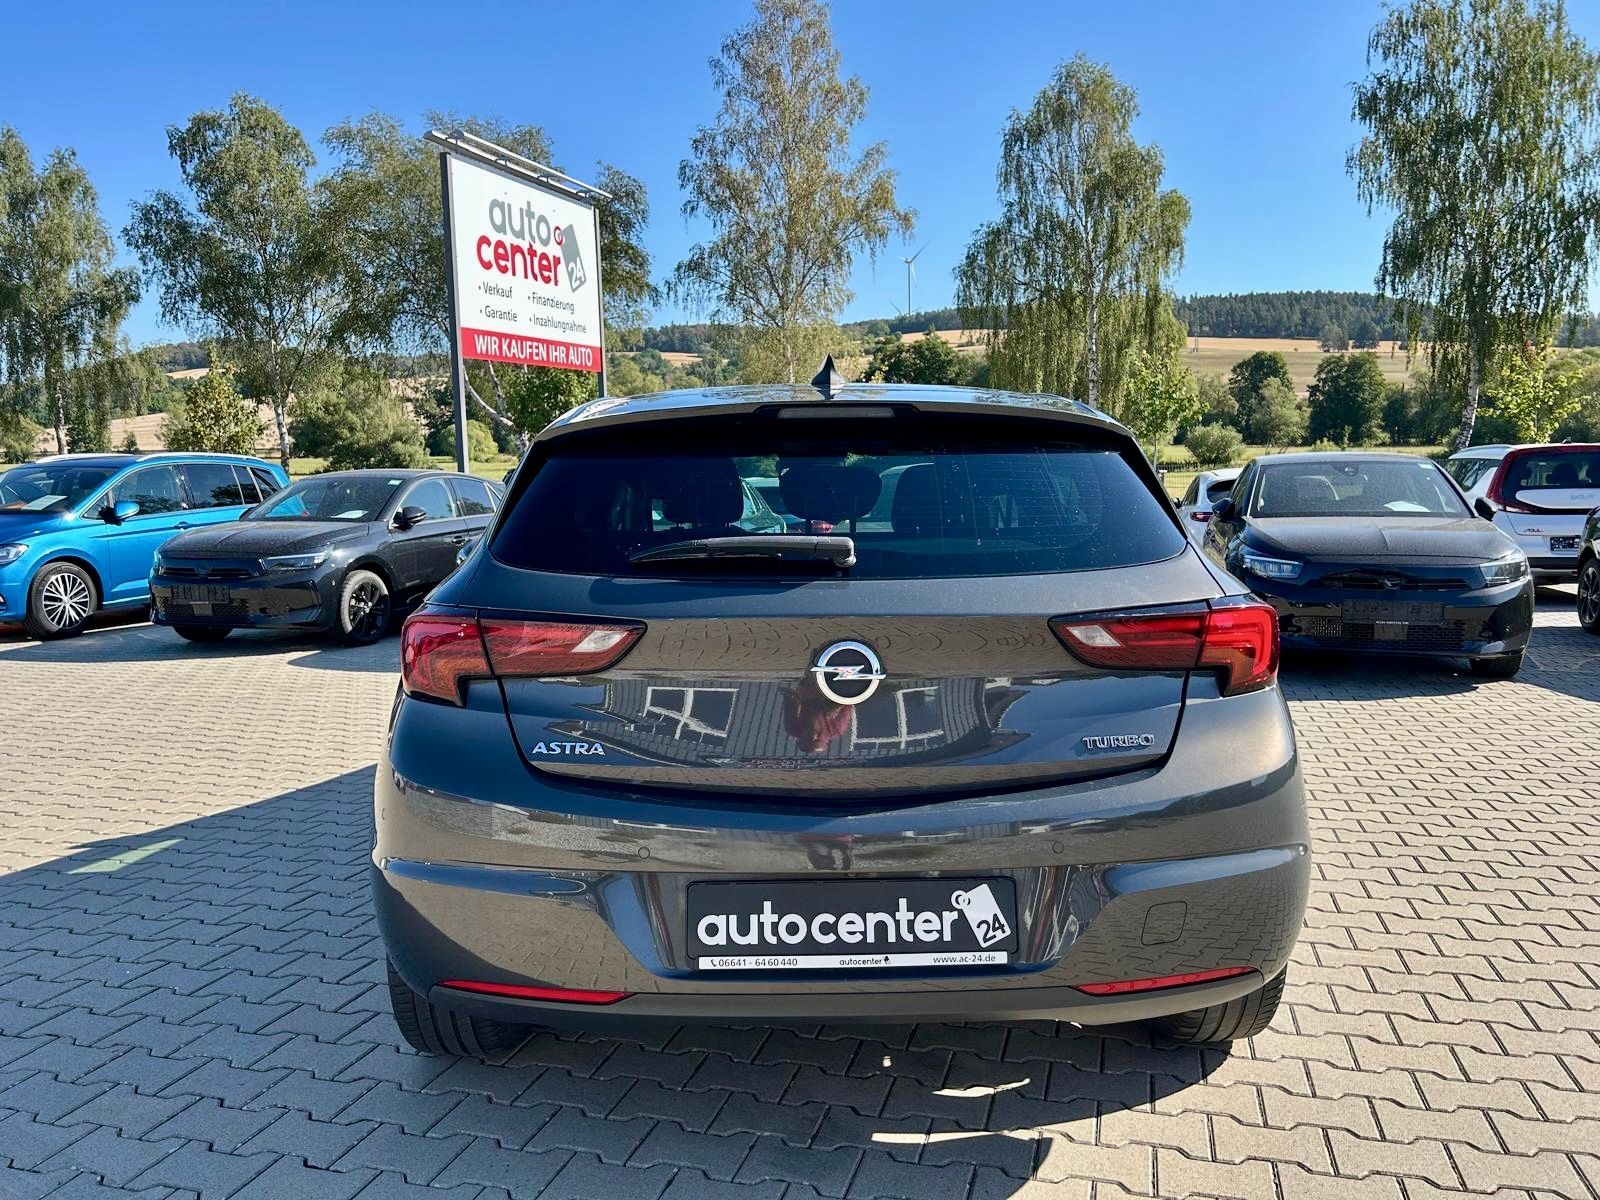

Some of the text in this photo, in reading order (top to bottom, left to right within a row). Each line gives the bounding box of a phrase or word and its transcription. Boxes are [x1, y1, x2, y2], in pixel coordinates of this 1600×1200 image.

[489, 199, 552, 247] auto
[477, 235, 585, 287] center 24
[483, 281, 513, 298] Verkauf
[532, 292, 574, 315] Finanzierung
[484, 305, 517, 322] Garantie
[533, 314, 586, 334] Inzahlungnahme
[475, 334, 593, 367] WIR KAUFEN IHR AUTO
[532, 741, 606, 755] ASTRA
[1082, 734, 1155, 749] TURBO
[697, 897, 1008, 945] autocenter 24
[718, 958, 746, 967] 06641
[839, 957, 882, 966] autocenter
[933, 953, 996, 964] www.ac-24.de
